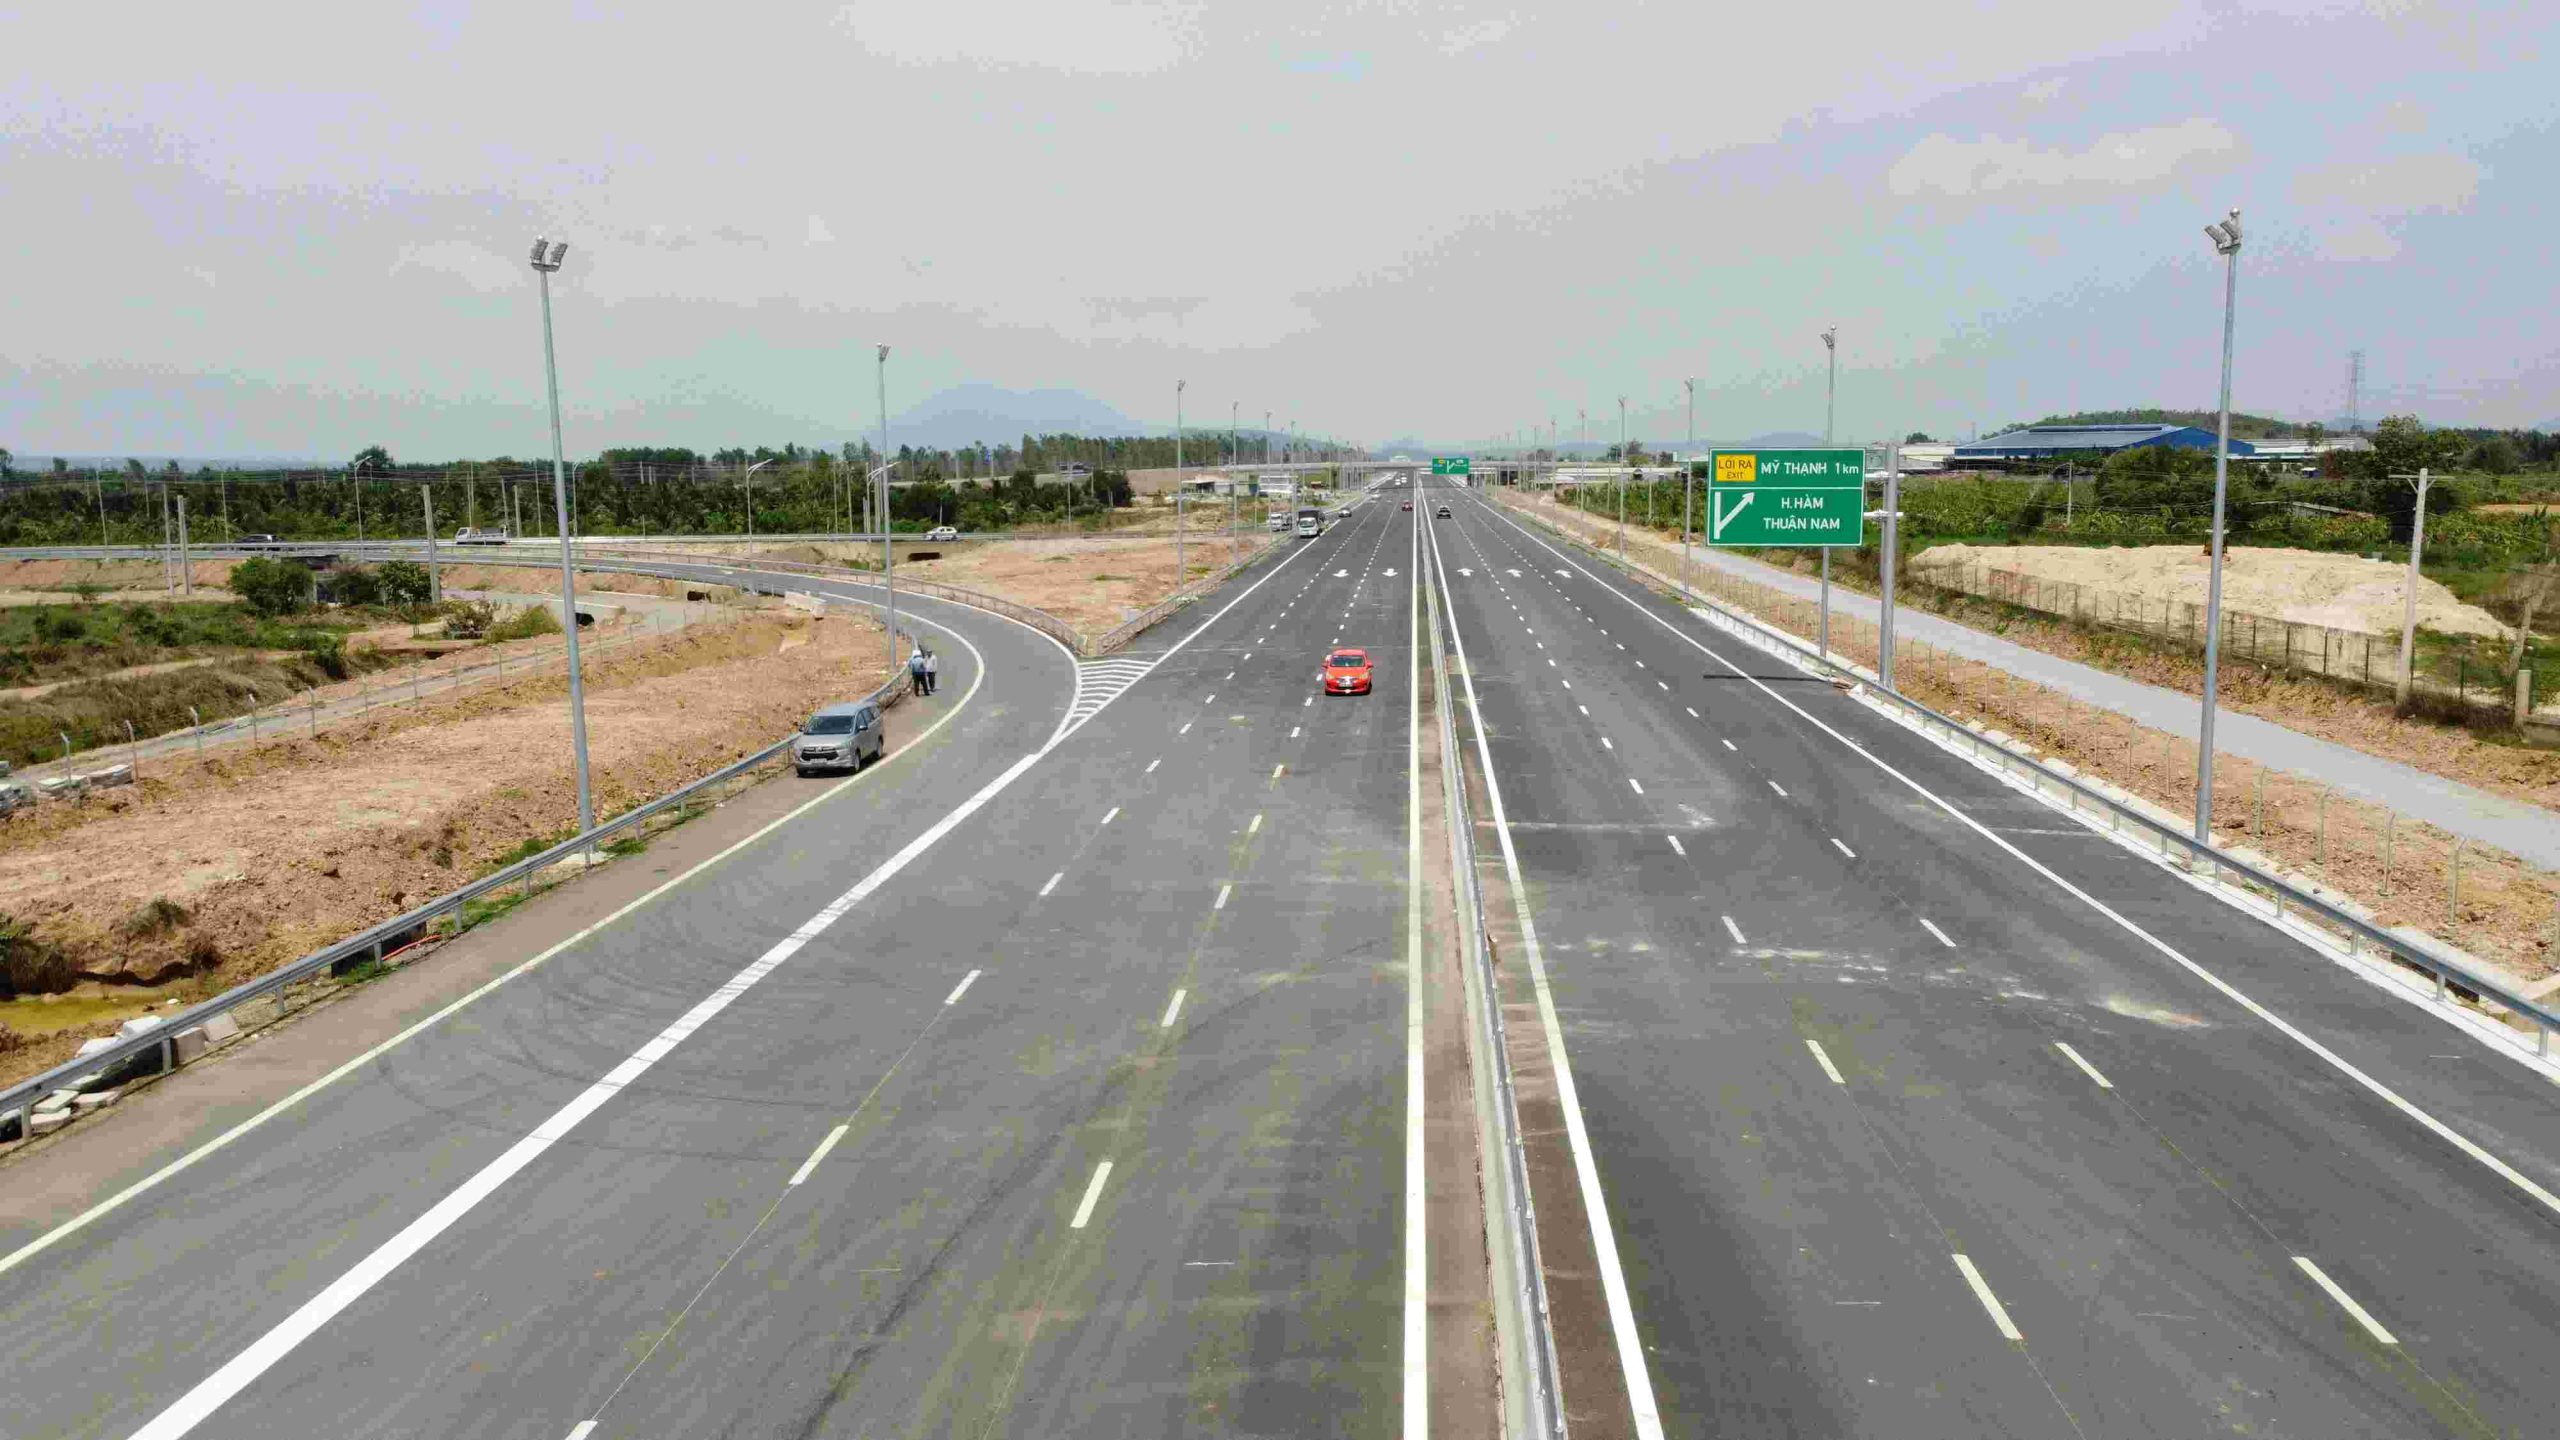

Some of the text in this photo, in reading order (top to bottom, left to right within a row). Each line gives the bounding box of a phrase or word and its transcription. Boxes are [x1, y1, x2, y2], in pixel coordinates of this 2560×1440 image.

[1738, 459, 1753, 469] RA
[1784, 462, 1827, 476] THẠNH
[1835, 462, 1840, 474] 1
[1842, 464, 1859, 474] km
[1763, 515, 1840, 532] THUẬN NAM
